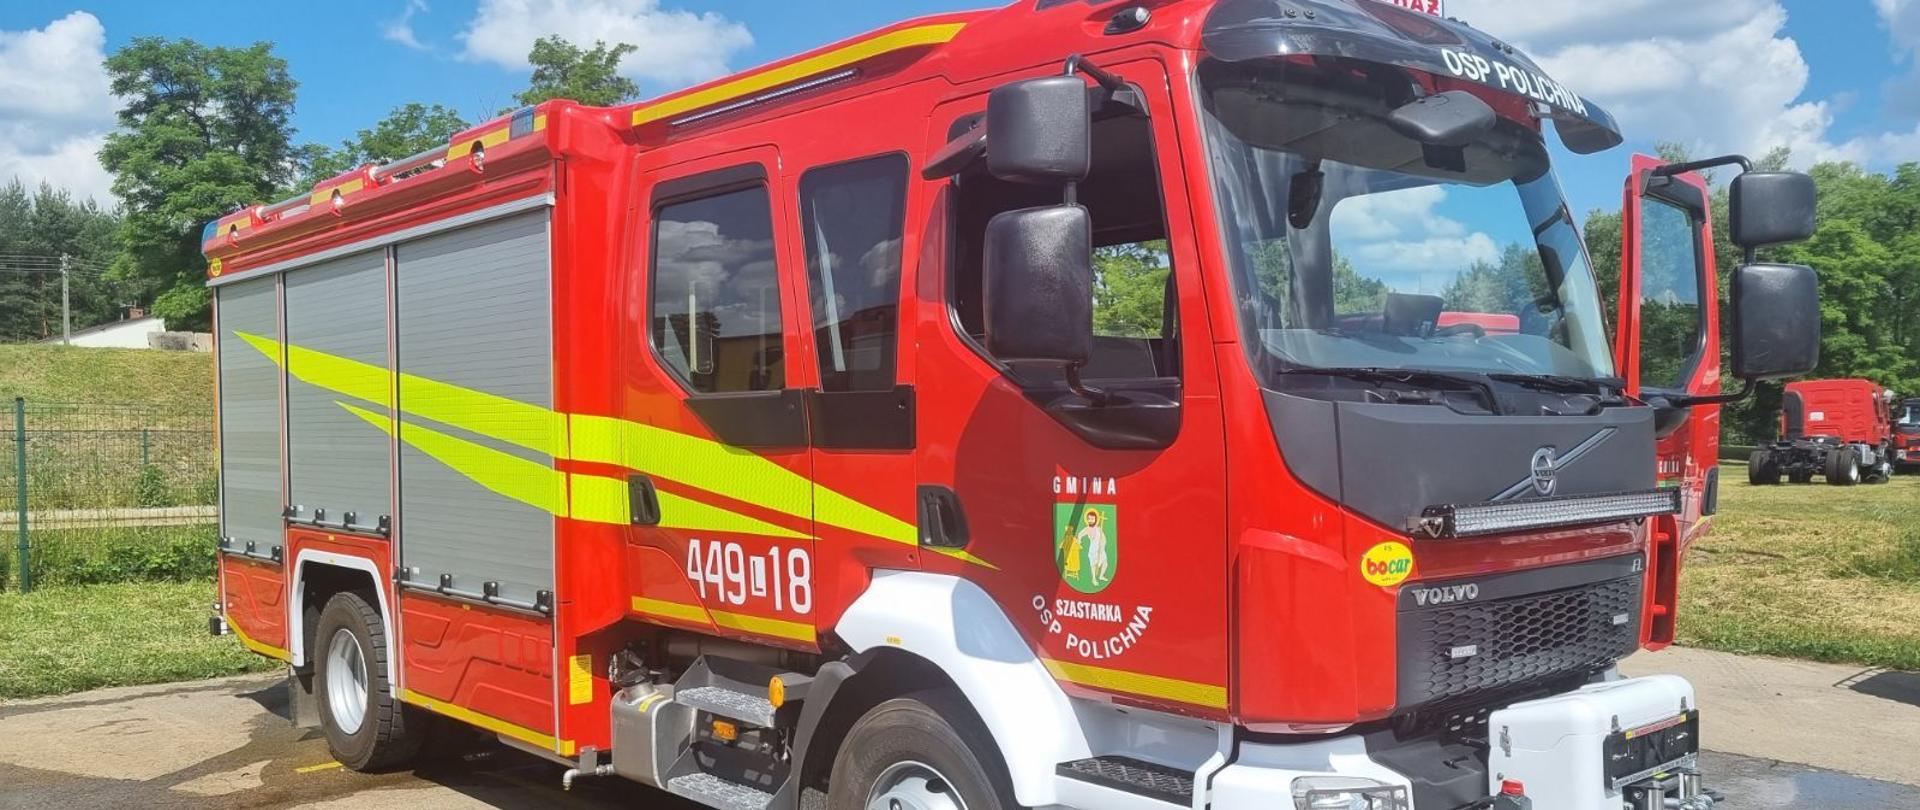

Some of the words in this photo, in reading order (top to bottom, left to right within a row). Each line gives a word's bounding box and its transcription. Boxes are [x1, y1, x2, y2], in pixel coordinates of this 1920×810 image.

[1441, 48, 1491, 83] OSP
[1492, 60, 1589, 118] POLICHNA
[1052, 476, 1116, 495] GMINA
[1366, 558, 1411, 575] bocar
[1411, 583, 1479, 606] VOLVO
[1055, 598, 1123, 623] SZASTARKA
[1032, 594, 1063, 635] OSP
[1065, 604, 1153, 660] POLICHNA
